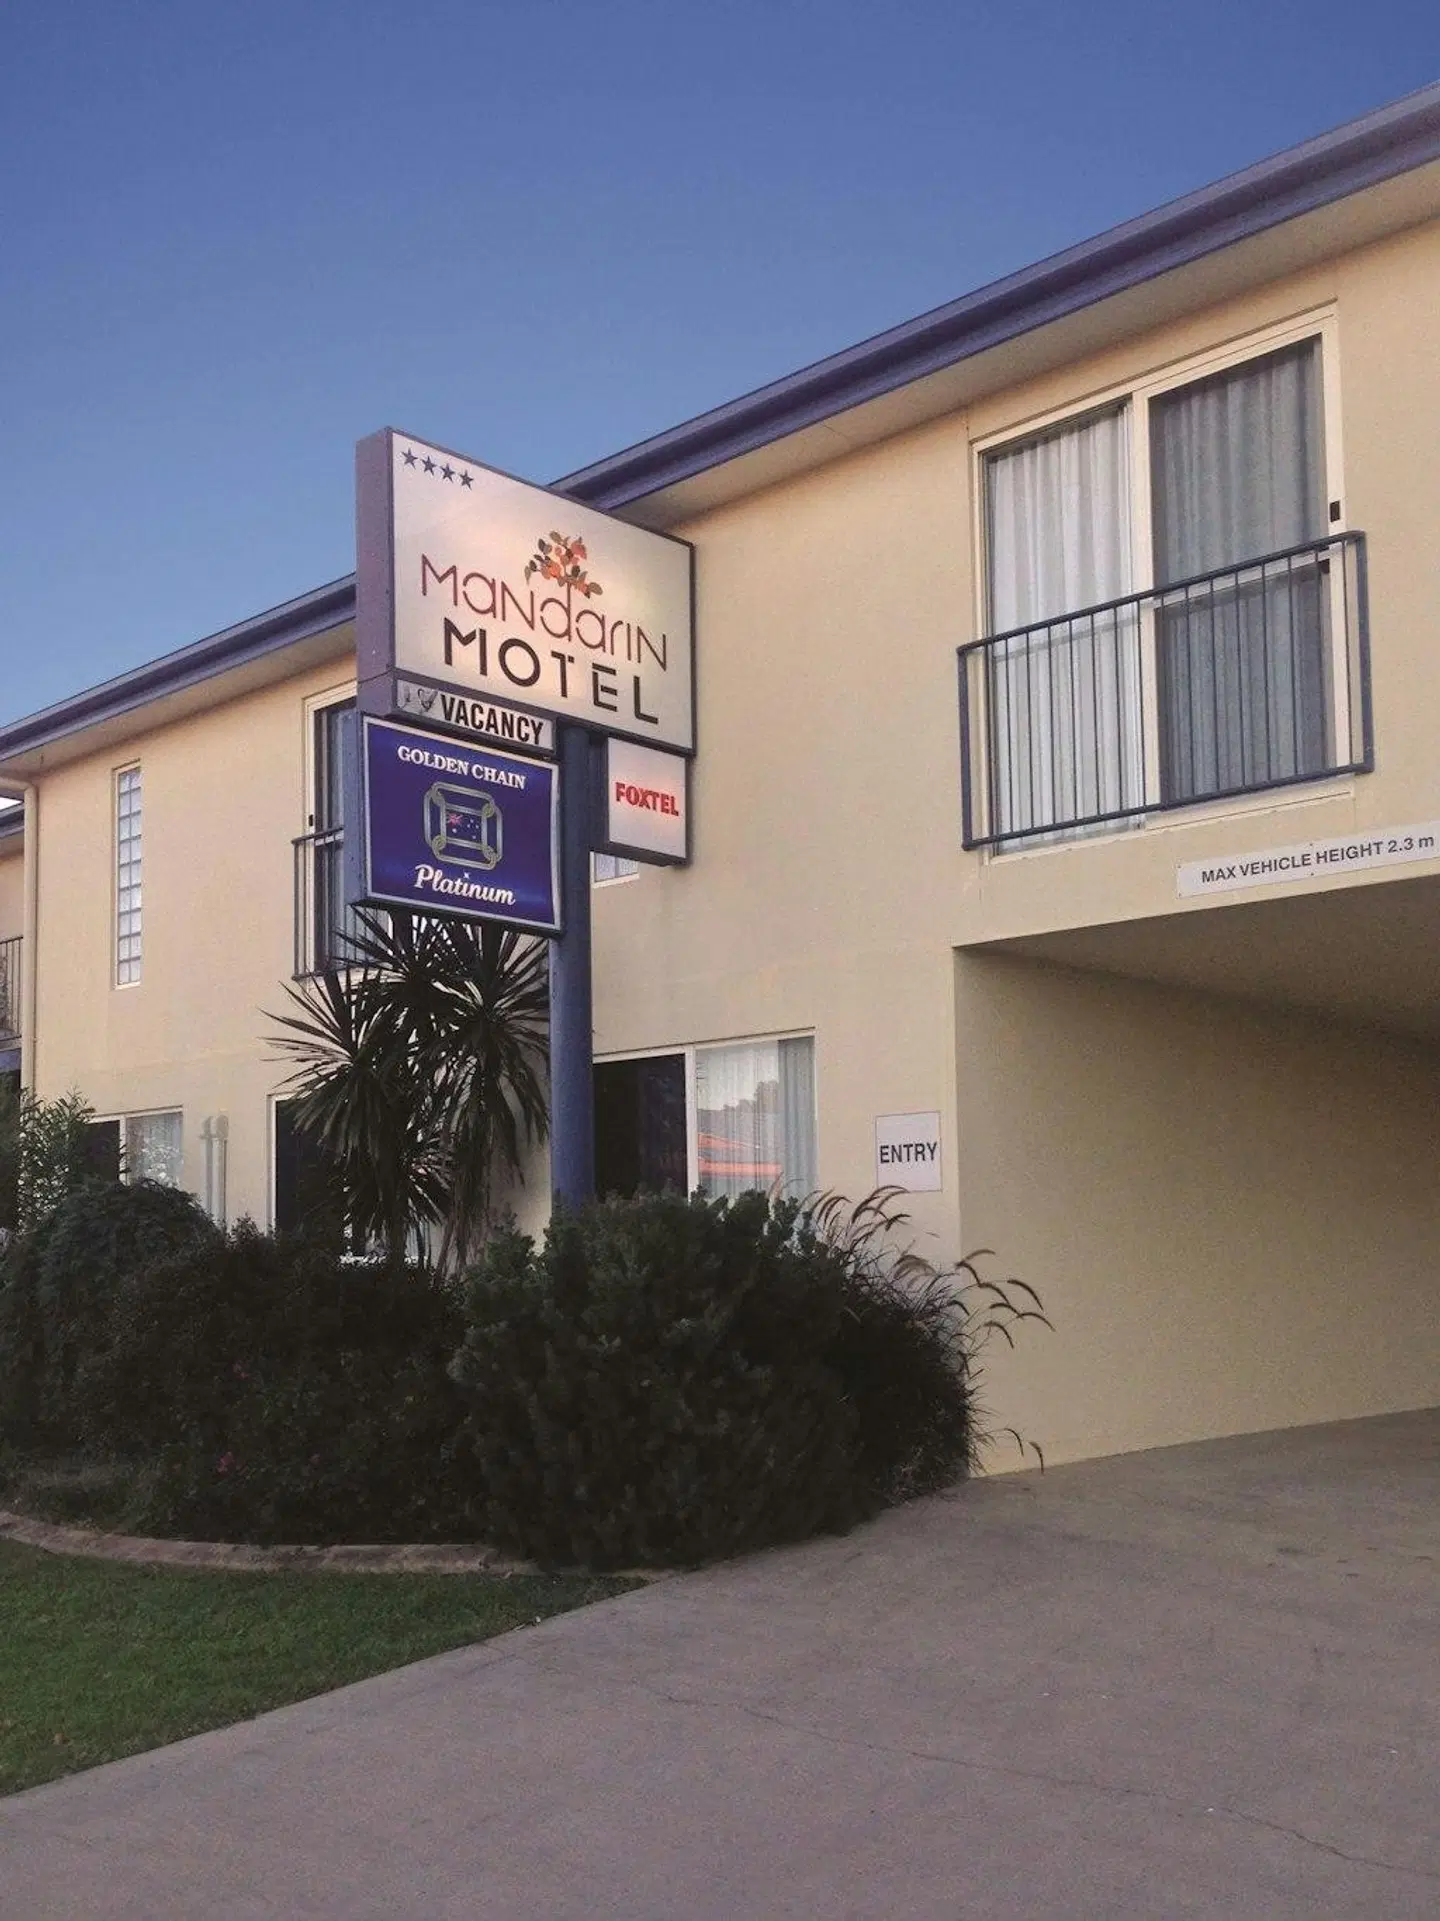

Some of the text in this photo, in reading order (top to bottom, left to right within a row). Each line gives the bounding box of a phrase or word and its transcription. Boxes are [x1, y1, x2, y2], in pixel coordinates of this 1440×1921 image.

[443, 617, 659, 725] MOTEL
[440, 693, 544, 745] VACANCY
[397, 745, 526, 791] GOLDEN CHAIN
[615, 781, 679, 817] FOXTEL
[1202, 835, 1435, 884] MAX VEHICLE HEIGHT 2.3 m
[414, 863, 516, 906] Platinum
[879, 1141, 938, 1164] ENTRY
